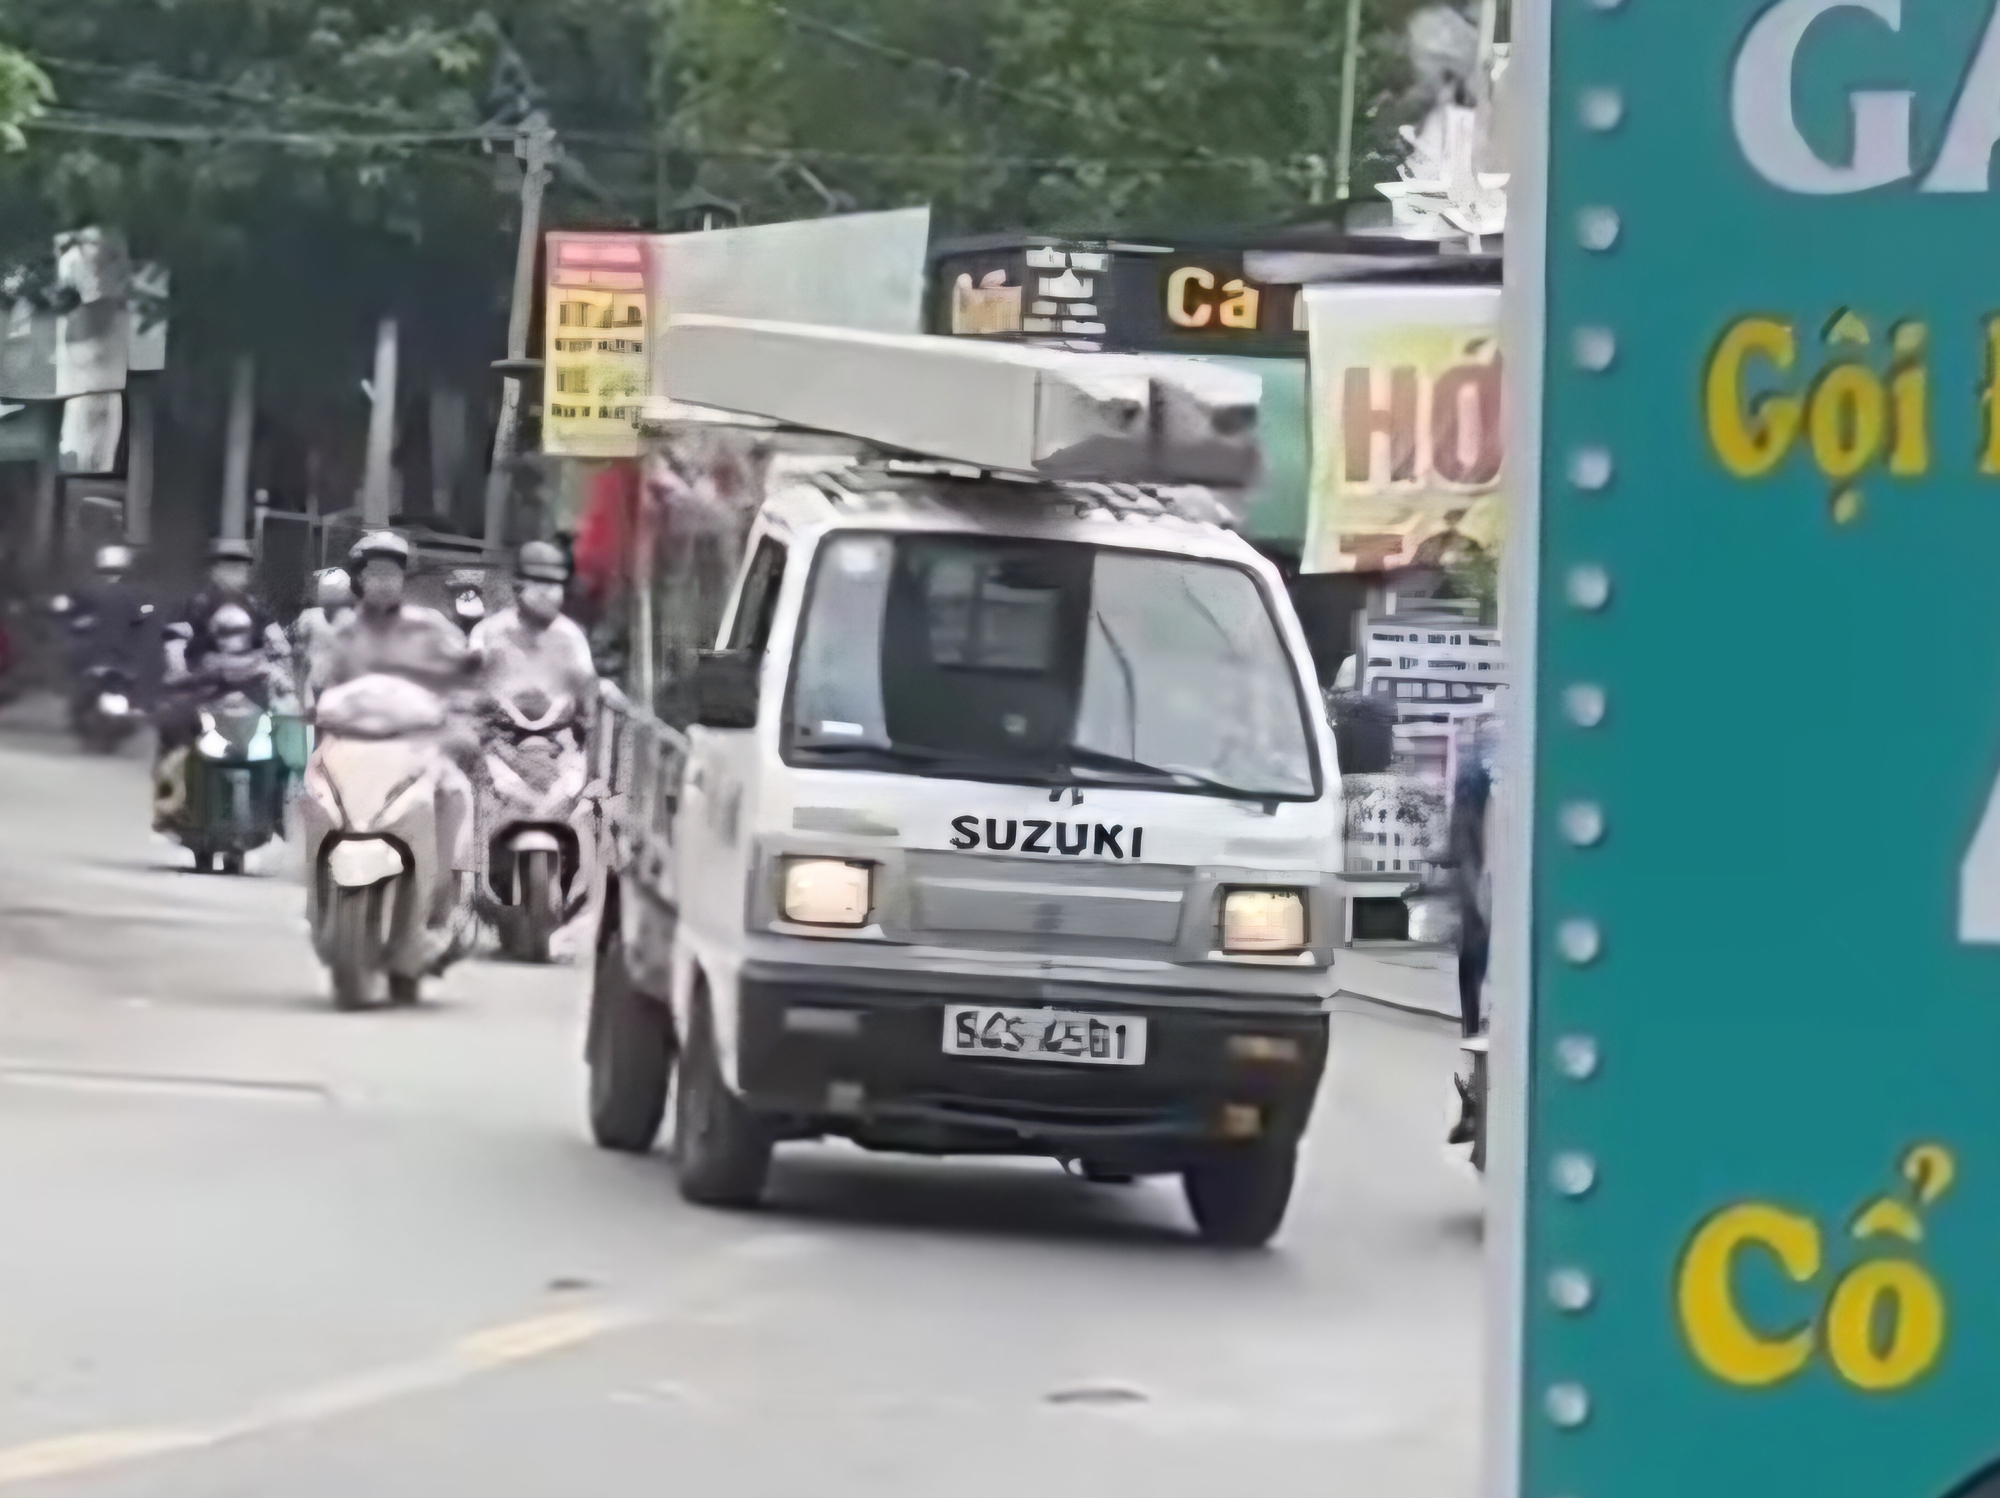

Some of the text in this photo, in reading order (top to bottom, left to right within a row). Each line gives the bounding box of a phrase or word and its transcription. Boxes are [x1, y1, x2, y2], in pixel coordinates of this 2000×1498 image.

[1705, 307, 1928, 524] Gội
[950, 814, 1144, 859] SUZUKI
[1678, 1142, 1953, 1391] Cổ
